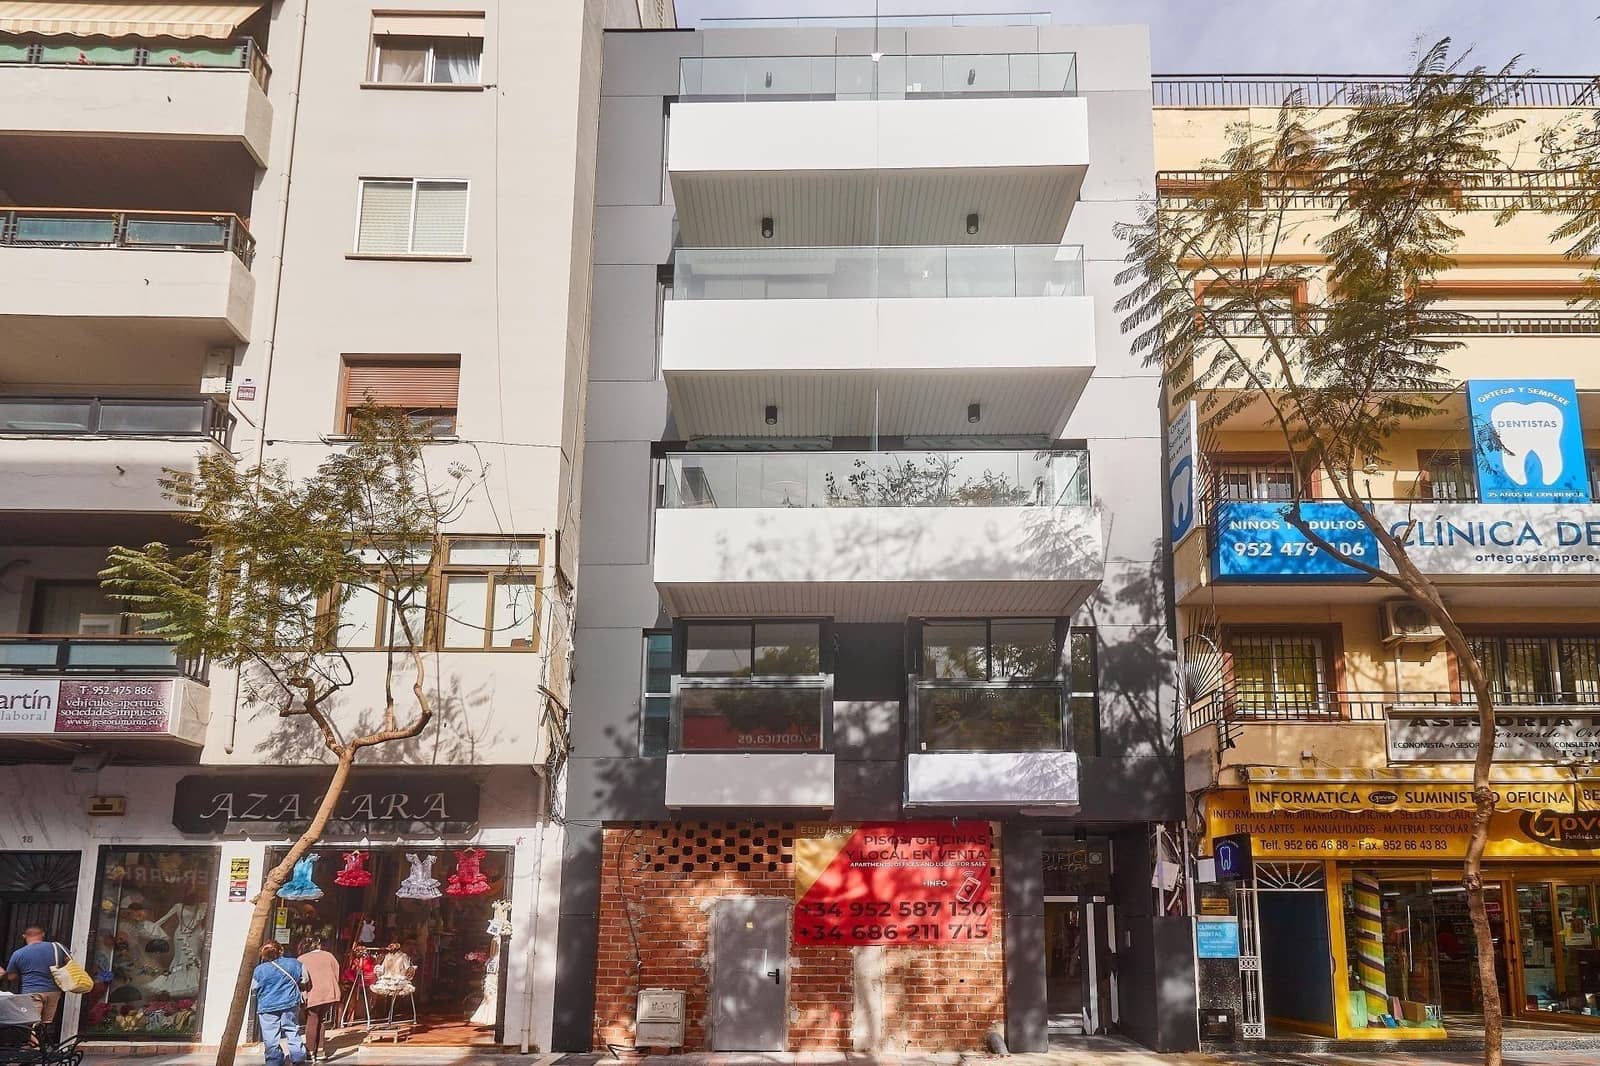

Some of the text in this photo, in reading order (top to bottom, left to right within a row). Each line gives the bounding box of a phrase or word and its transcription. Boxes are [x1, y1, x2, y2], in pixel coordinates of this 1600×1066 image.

[1478, 387, 1515, 403] ORTEGA
[1528, 387, 1570, 406] SEMPERE
[1498, 420, 1558, 428] DENTISTAS
[1309, 520, 1366, 530] DULTOS
[1389, 515, 1542, 546] CLÍNICA
[1233, 542, 1272, 556] 952
[1280, 542, 1319, 556] 479
[1475, 554, 1600, 564] ortegaysempere.
[93, 686, 110, 694] 952
[113, 686, 132, 694] 475
[134, 686, 153, 694] 886
[0, 690, 51, 710] artín
[1, 710, 47, 721] laboral
[1255, 792, 1361, 804] INFORMATICA
[1405, 792, 1500, 804] SUMINISTO
[1506, 792, 1570, 804] OFICINA
[199, 791, 450, 820] AZAARA
[1235, 824, 1266, 833] BELLAS
[1269, 824, 1295, 833] ARTES
[1304, 824, 1375, 833] MANUALIDADES
[1384, 824, 1427, 833] MATERIAL
[1430, 824, 1469, 833] ESCOLAR
[916, 834, 987, 845] OFICINAS
[1284, 840, 1303, 849] 952
[1305, 840, 1318, 849] 66
[1321, 840, 1333, 849] 46
[1336, 840, 1349, 849] 88
[1359, 840, 1380, 850] Fax.
[1383, 840, 1402, 849] 952
[1404, 840, 1417, 849] 66
[1420, 840, 1432, 849] 43
[1434, 840, 1447, 849] 83
[847, 850, 987, 860] Y LOCAL EN VENTA
[801, 902, 987, 917] +34 952 587 130
[801, 924, 988, 940] +34 686 211 715
